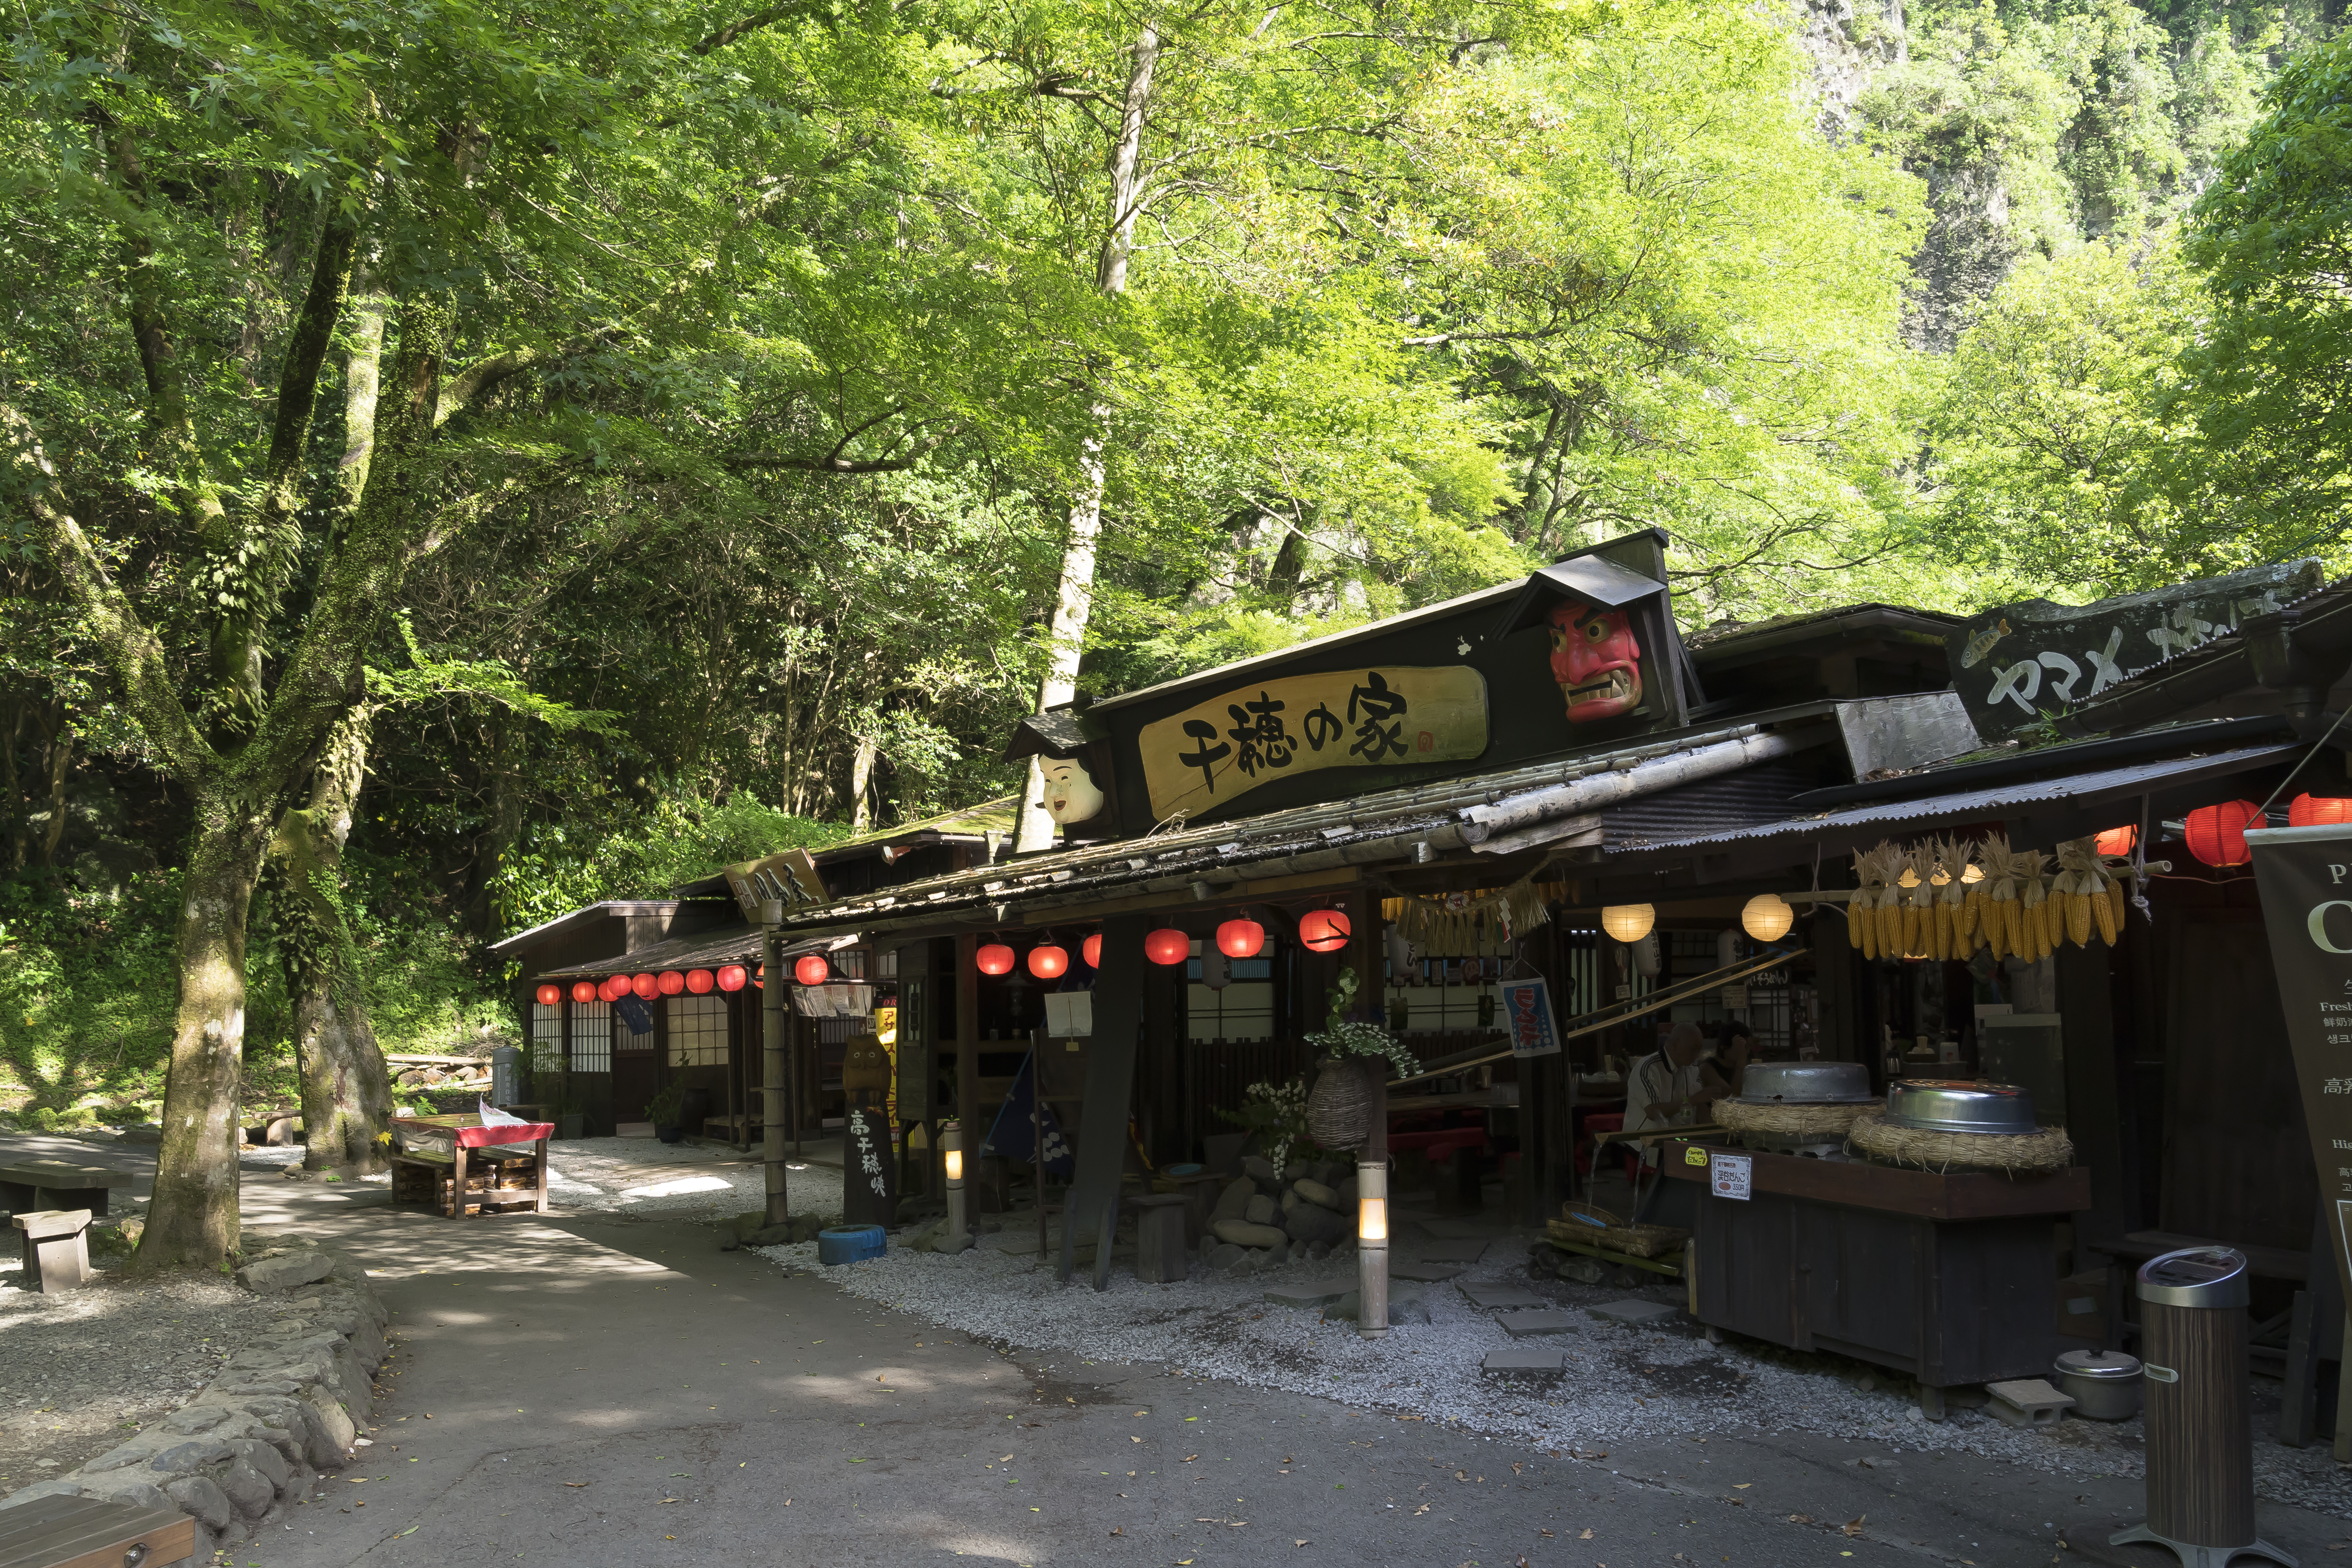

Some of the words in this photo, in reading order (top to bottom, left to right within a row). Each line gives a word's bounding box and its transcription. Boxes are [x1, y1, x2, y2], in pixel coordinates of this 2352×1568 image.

[1178, 670, 1409, 795] 千穂の家
[2328, 863, 2352, 884] P
[2327, 1034, 2352, 1044] 생크
[851, 1110, 886, 1197] 高千穂峡
